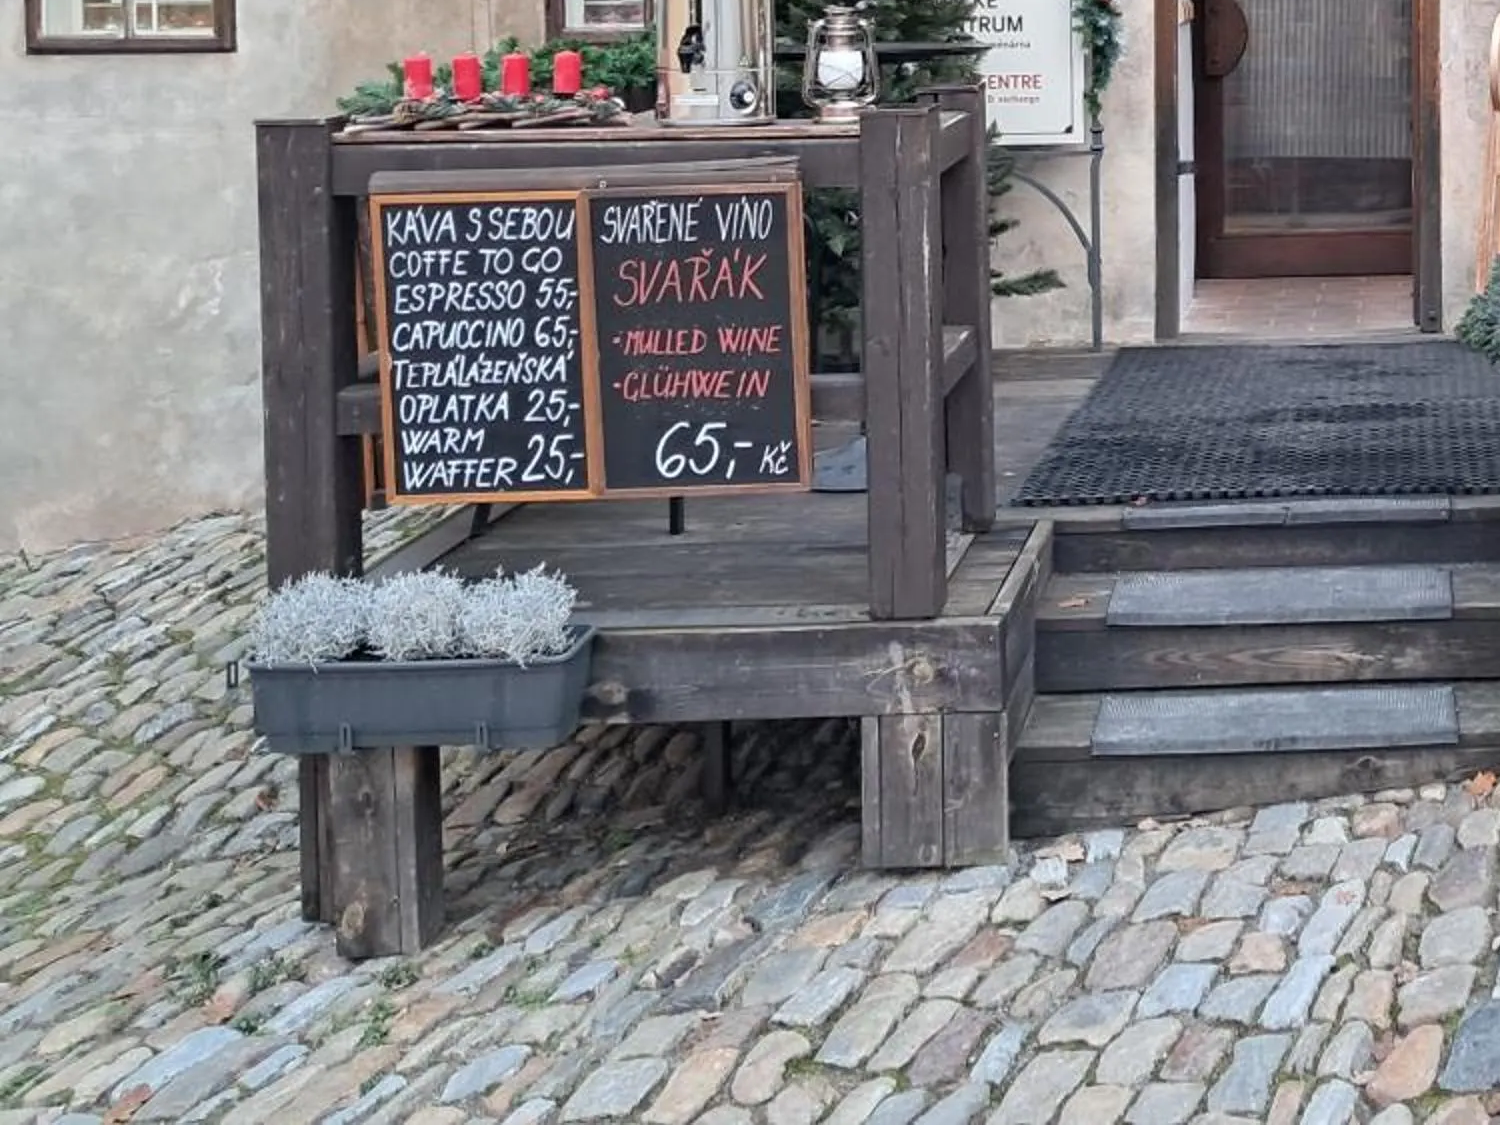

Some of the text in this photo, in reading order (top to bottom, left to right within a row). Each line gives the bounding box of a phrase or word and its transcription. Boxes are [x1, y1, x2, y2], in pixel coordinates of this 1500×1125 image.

[987, 74, 1042, 89] ENTRE
[386, 206, 575, 247] KÁVA S SEBOU
[600, 196, 773, 244] SVAŘENÉ VÍNO
[389, 246, 562, 278] COFFE TO GO
[613, 247, 768, 307] SVAŘÁK
[394, 279, 526, 314] ESPRESSO
[392, 318, 525, 352] CAPUCCINO
[718, 325, 783, 356] WINE
[400, 390, 509, 424] OPLATKA
[402, 427, 485, 455] WARM
[759, 440, 792, 475] Kč
[403, 457, 518, 491] WAFFER
